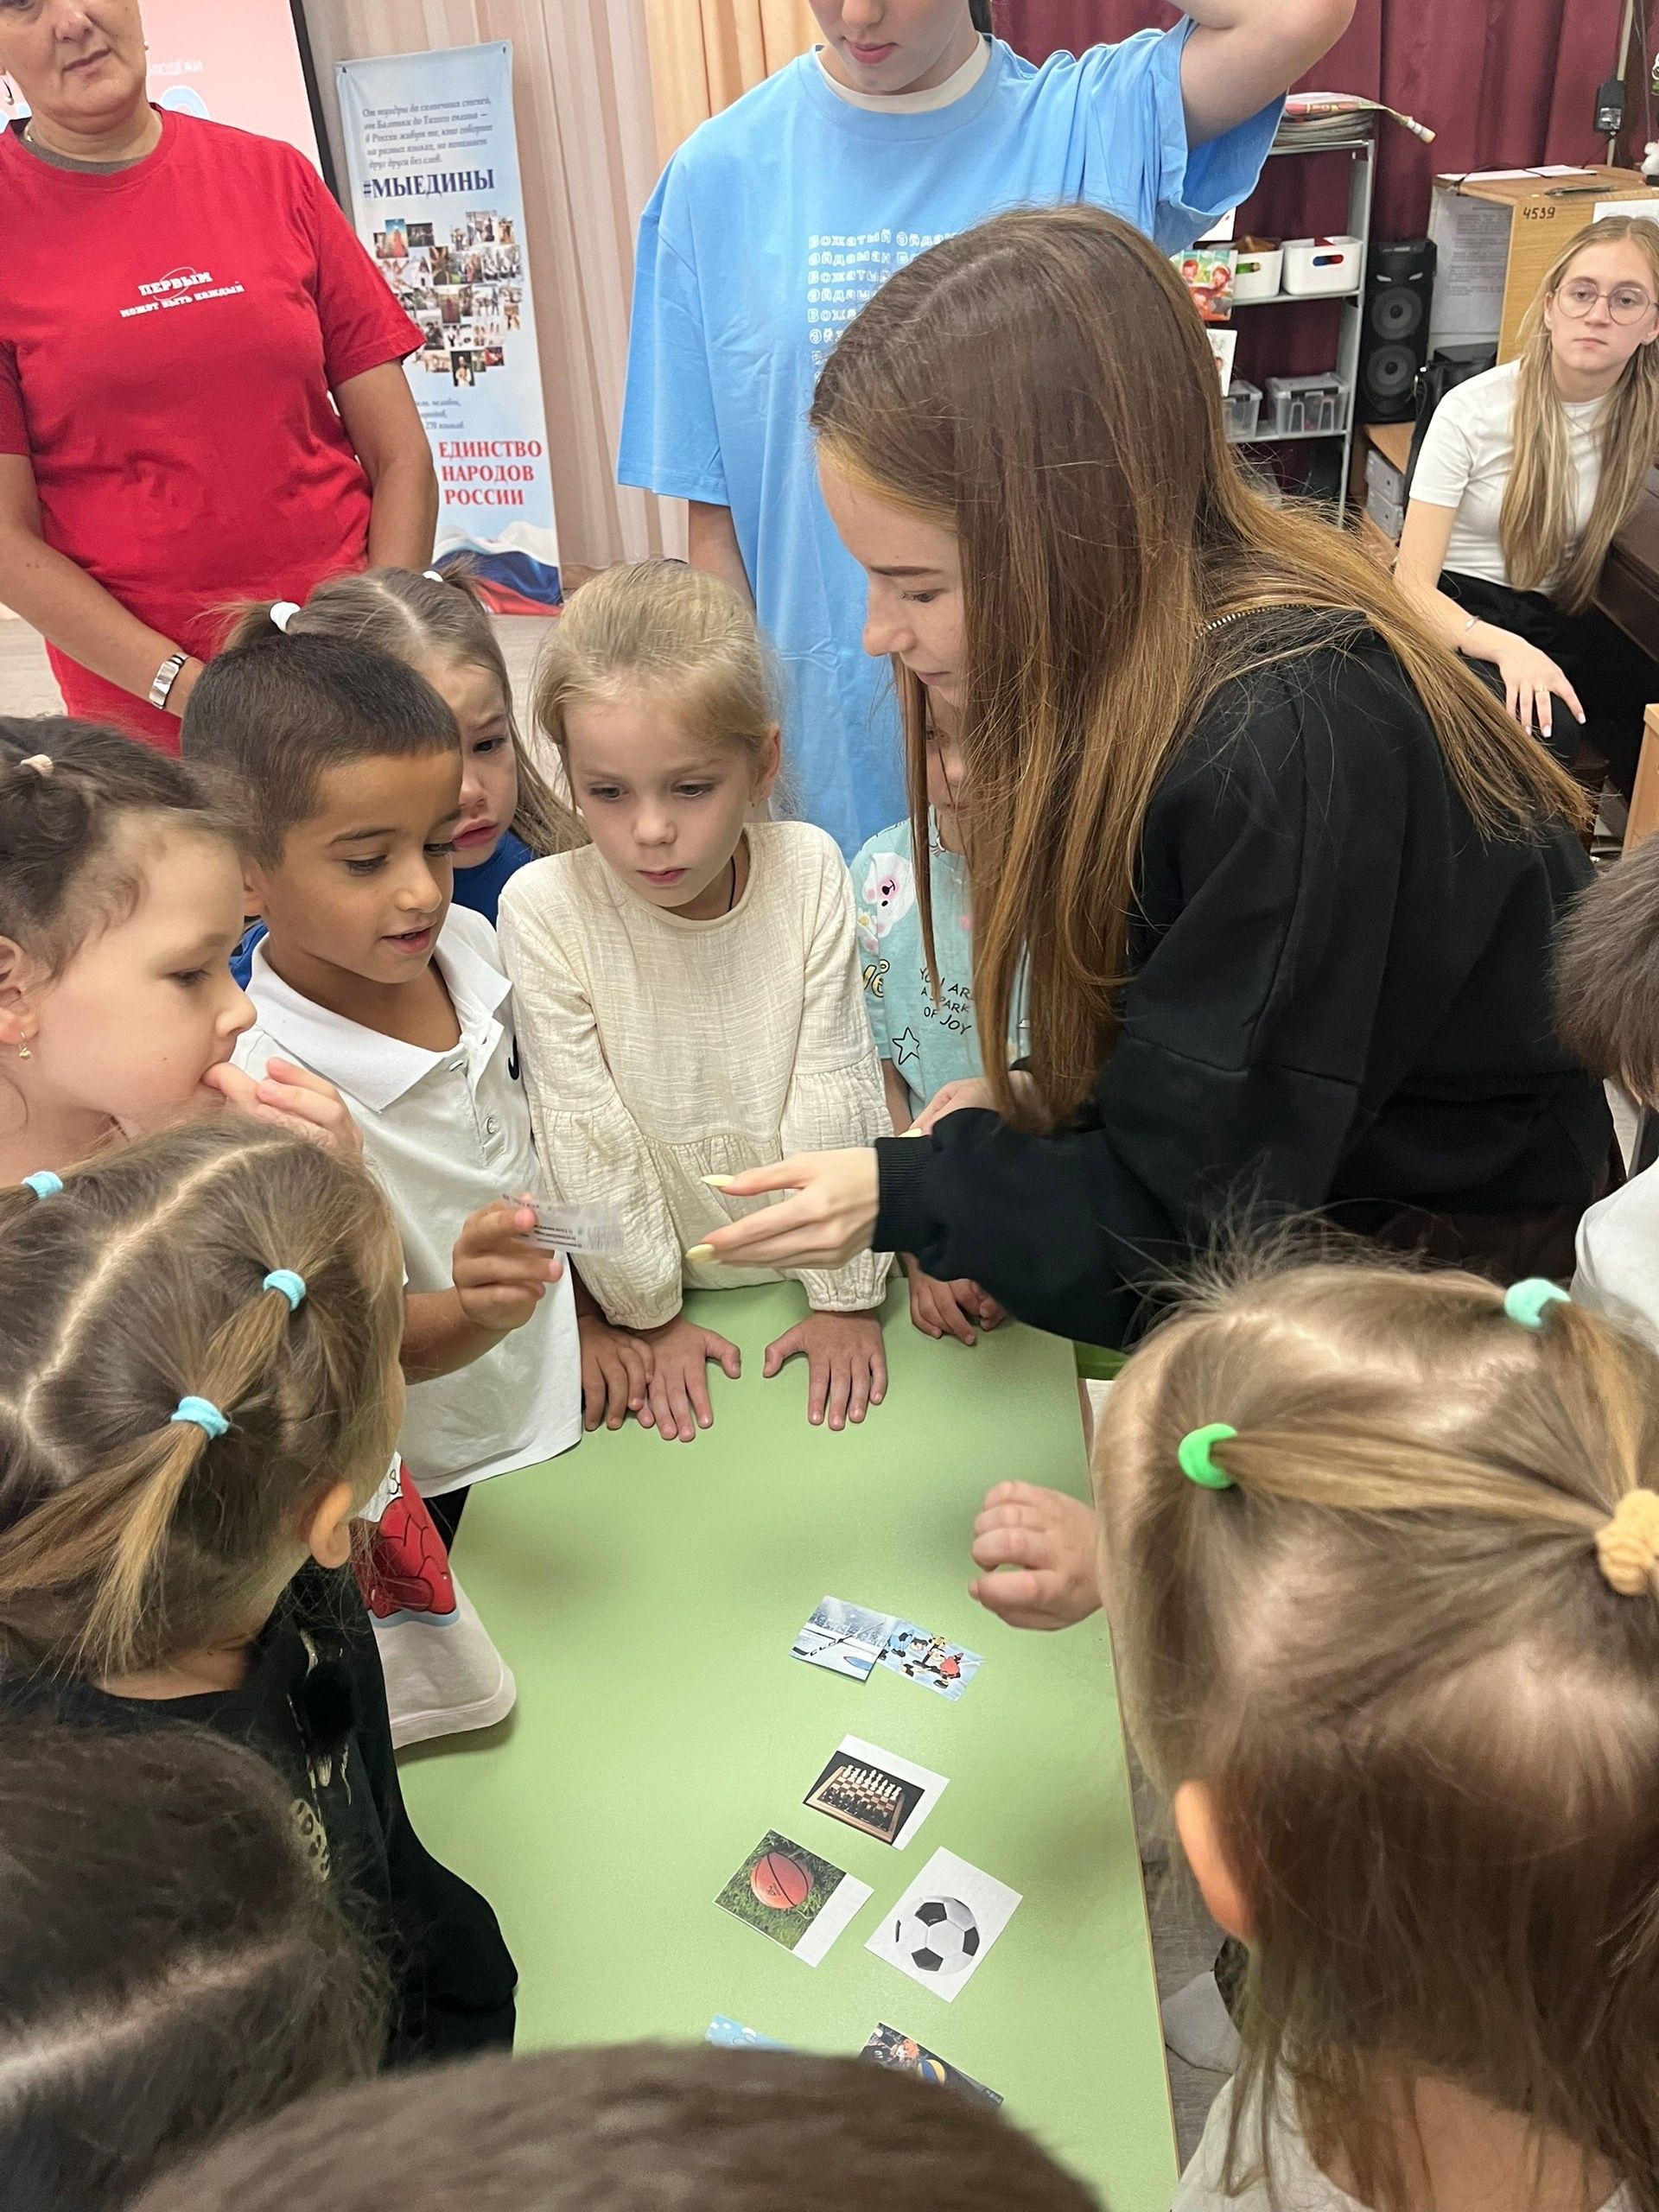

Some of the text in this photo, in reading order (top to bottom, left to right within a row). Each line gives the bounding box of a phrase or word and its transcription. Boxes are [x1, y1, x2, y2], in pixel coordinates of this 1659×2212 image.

[364, 169, 494, 198] #МЫЕДИНЫ
[1523, 207, 1556, 219] 4539
[138, 271, 213, 296] ПЕРВЫМ
[438, 441, 543, 461] ЕДИНСТВО
[442, 465, 535, 485] НАРОДОВ
[445, 489, 524, 505] РОССИИ
[939, 1014, 972, 1035] JOY
